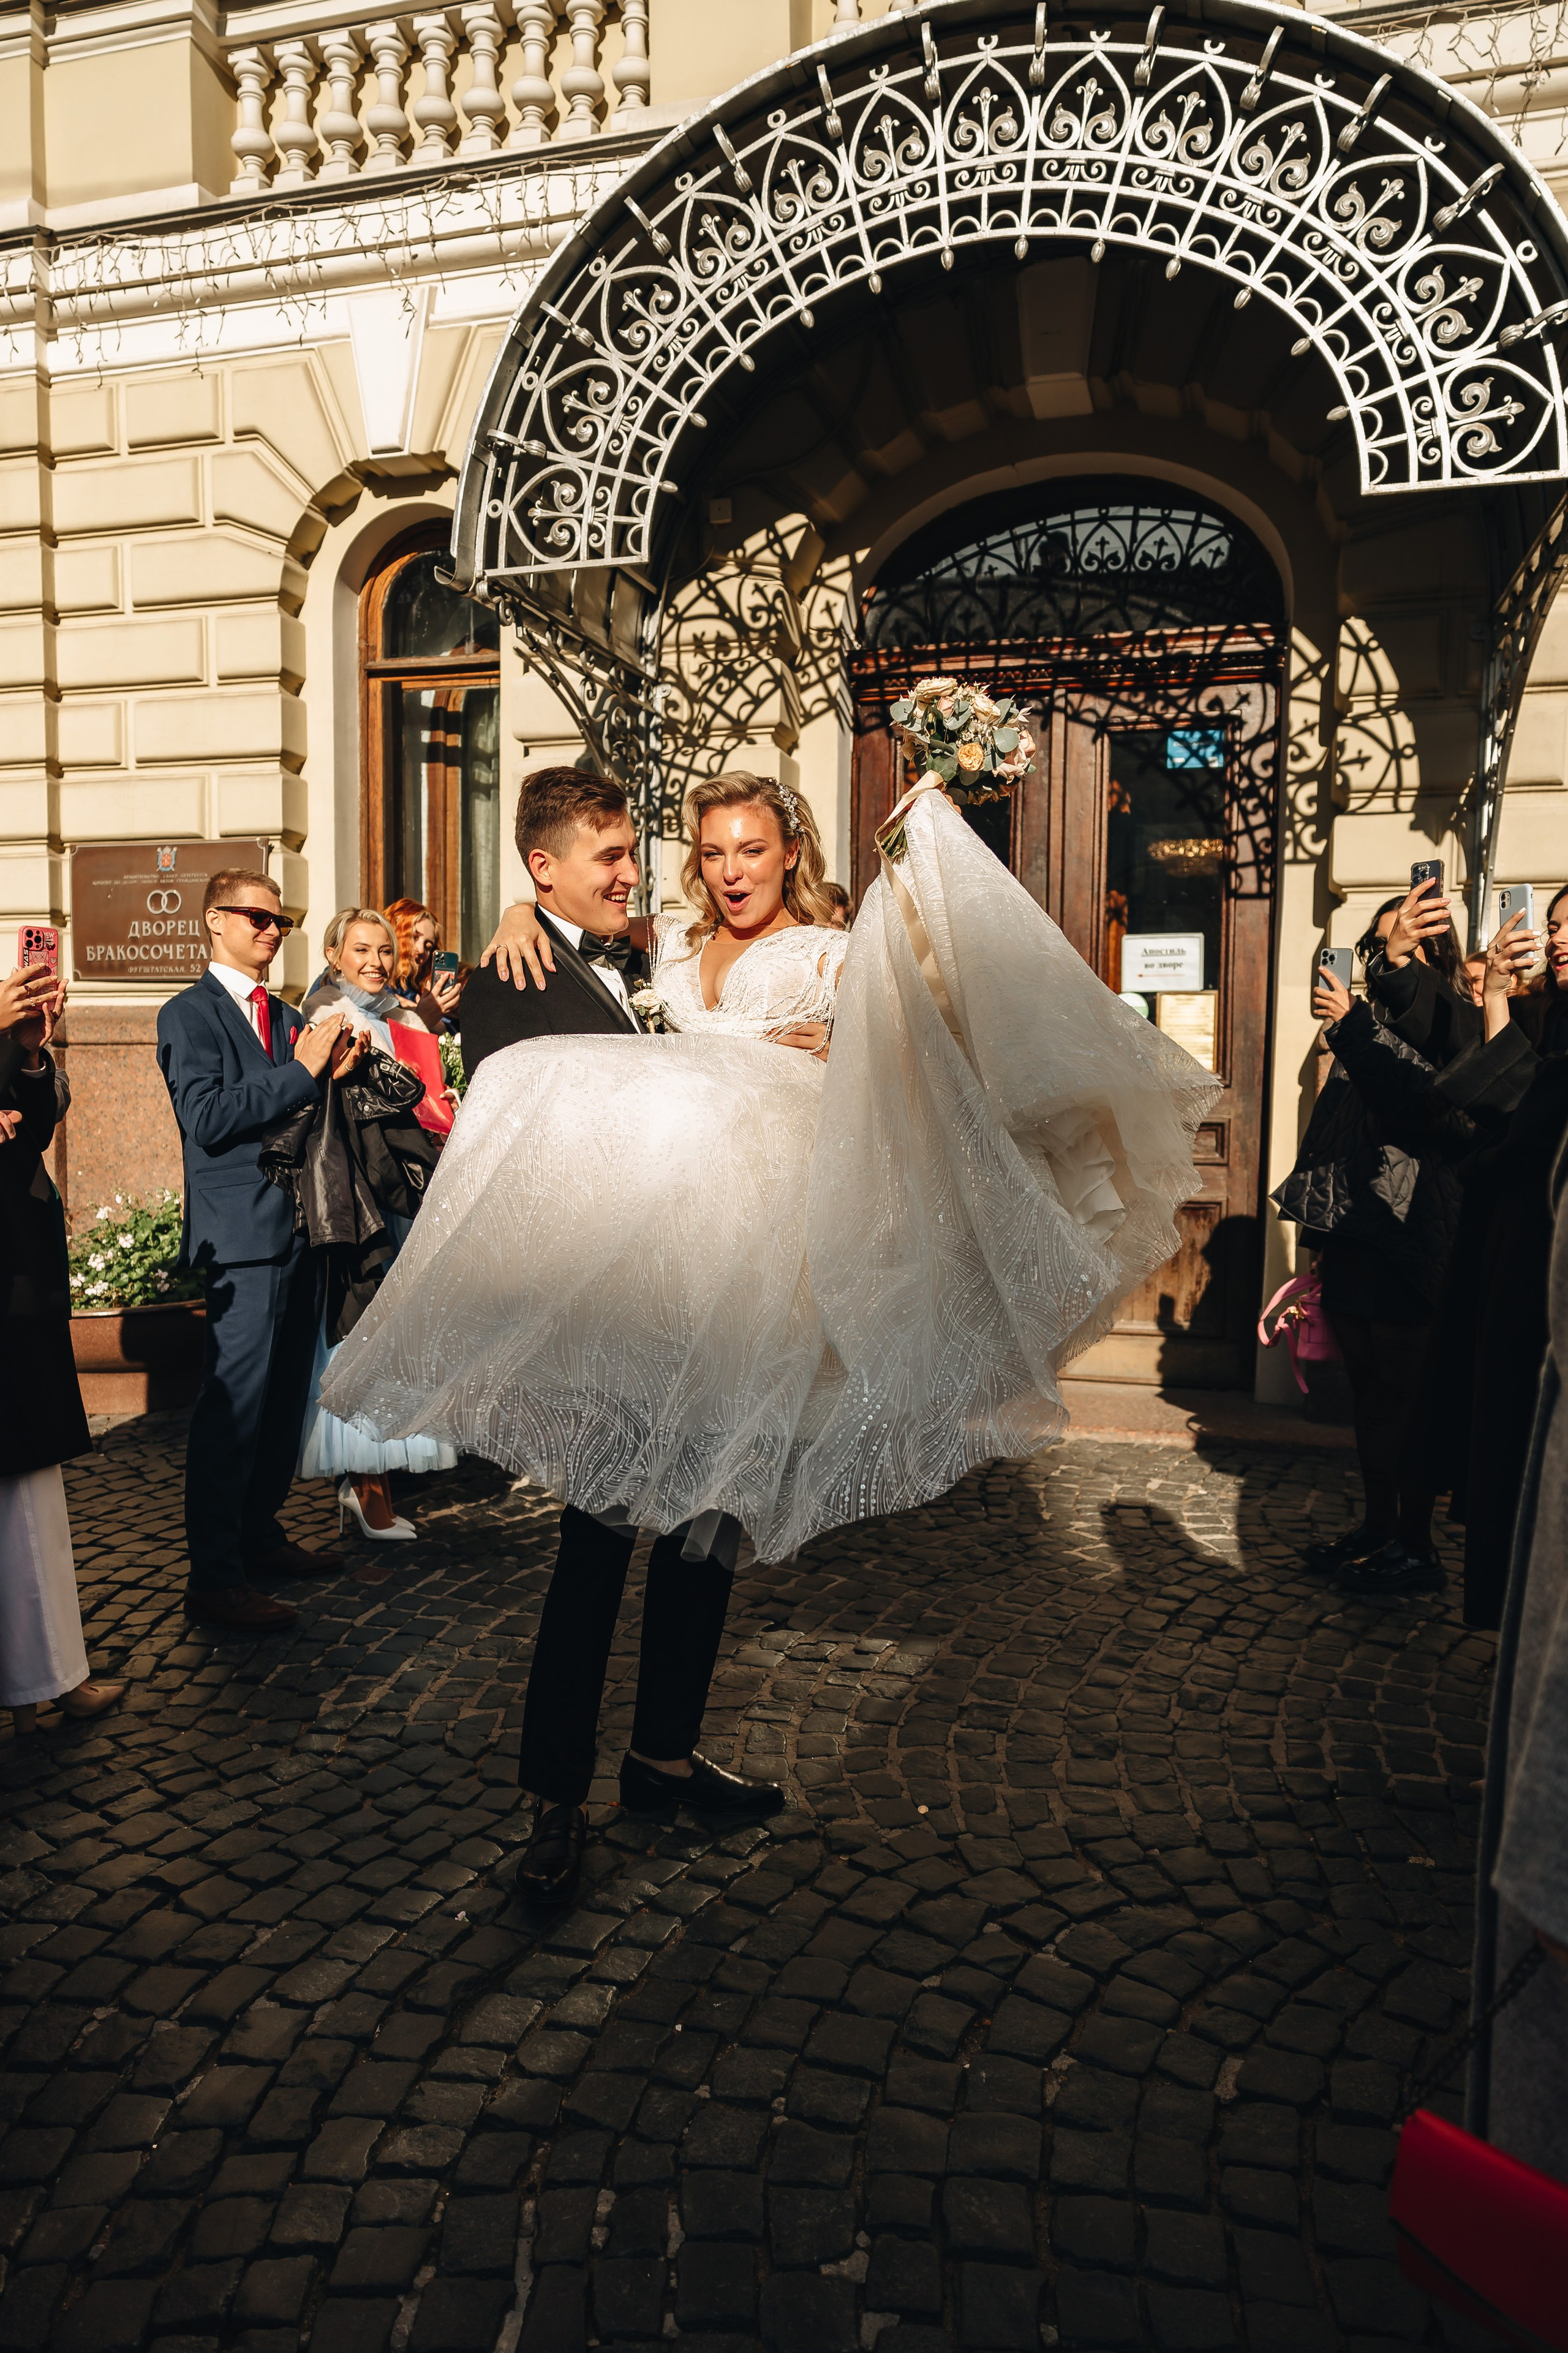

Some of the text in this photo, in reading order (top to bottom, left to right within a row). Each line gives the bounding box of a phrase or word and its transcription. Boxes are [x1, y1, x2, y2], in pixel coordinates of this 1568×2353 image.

[128, 920, 201, 939] ДВОРЕЦ
[86, 943, 213, 962] БРАКОСОЧЕТА
[190, 964, 201, 973] 52
